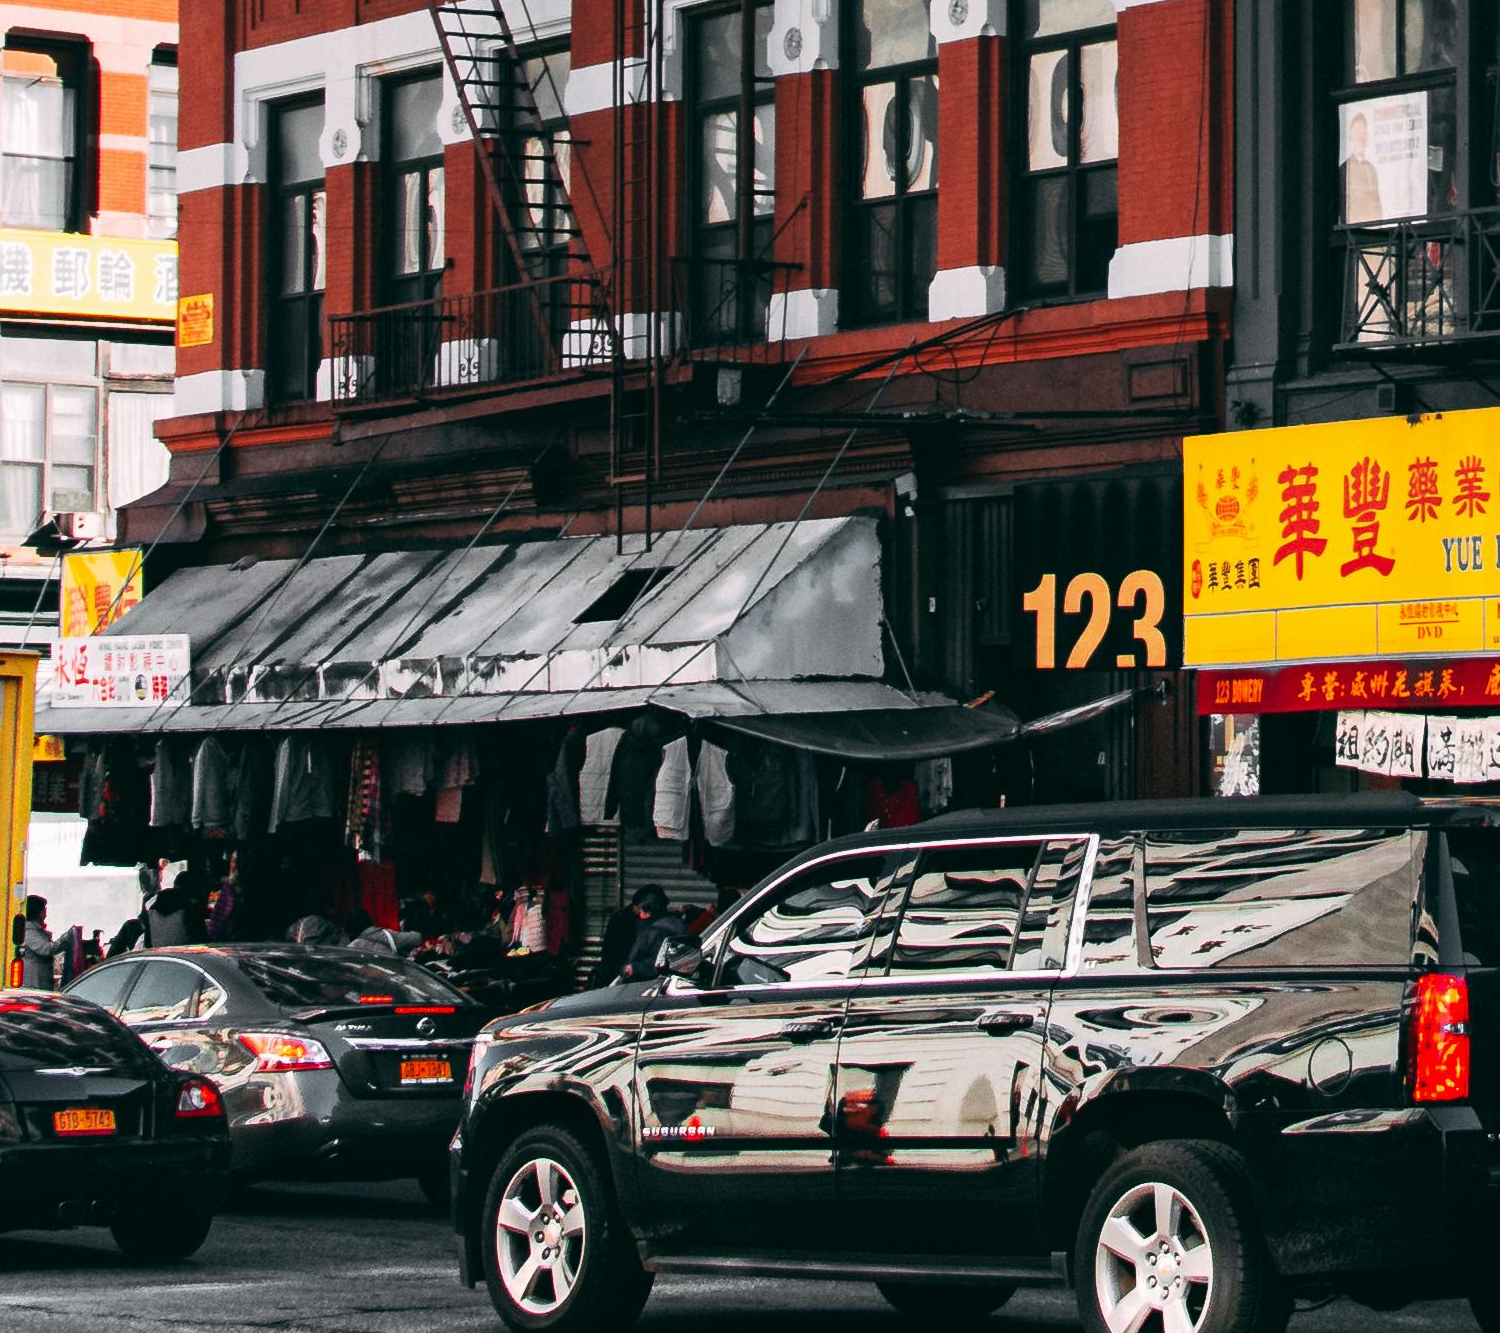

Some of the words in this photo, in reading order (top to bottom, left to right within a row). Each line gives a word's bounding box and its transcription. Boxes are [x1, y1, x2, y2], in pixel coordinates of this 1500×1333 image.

[1441, 535, 1484, 573] YUE
[1022, 569, 1167, 669] 123
[1417, 626, 1443, 640] DVD
[1214, 680, 1231, 704] 123
[1232, 678, 1264, 704] BOWERY
[642, 1126, 716, 1137] SUBURBAN
